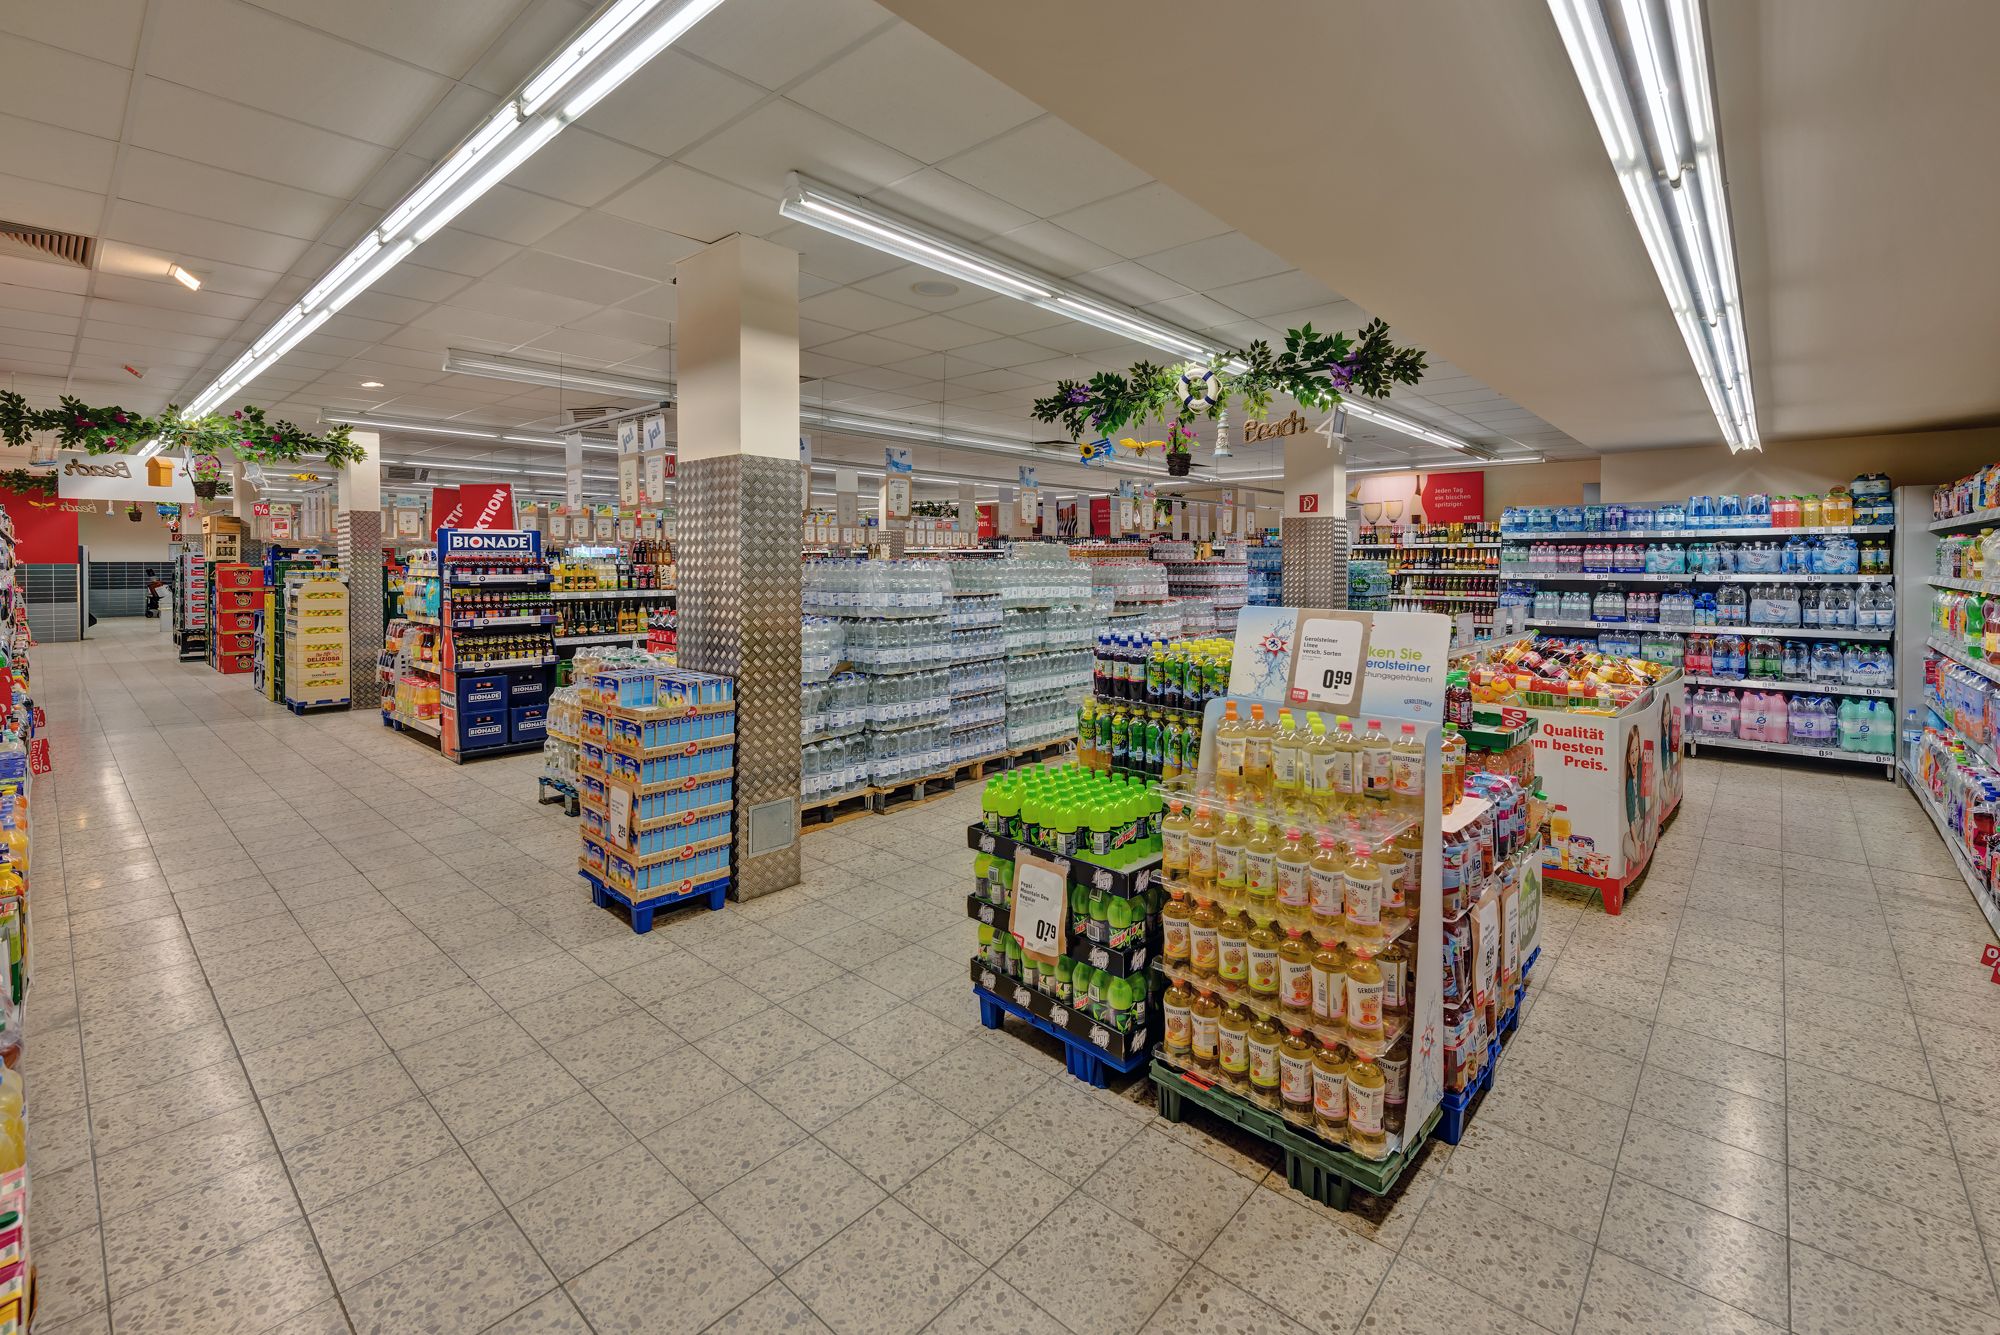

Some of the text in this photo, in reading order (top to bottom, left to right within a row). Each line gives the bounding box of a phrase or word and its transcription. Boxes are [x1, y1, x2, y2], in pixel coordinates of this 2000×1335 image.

[1243, 409, 1309, 444] Beach
[1453, 487, 1464, 495] Tag
[452, 536, 529, 549] BIONADE
[1304, 635, 1338, 644] Gerolsteiner
[1302, 648, 1322, 656] versch.
[1368, 647, 1422, 660] ken Sie
[1366, 660, 1431, 673] erolsteiner
[513, 684, 541, 693] BIONADE
[470, 692, 500, 702] BIONADE
[470, 725, 500, 735] BIONADE
[1543, 723, 1605, 741] Qualität
[1552, 738, 1604, 756] besten
[1564, 755, 1608, 772] Preis.
[1020, 880, 1033, 889] Pepsi
[1020, 887, 1050, 902] Mountain Dew
[1020, 893, 1036, 903] Regular
